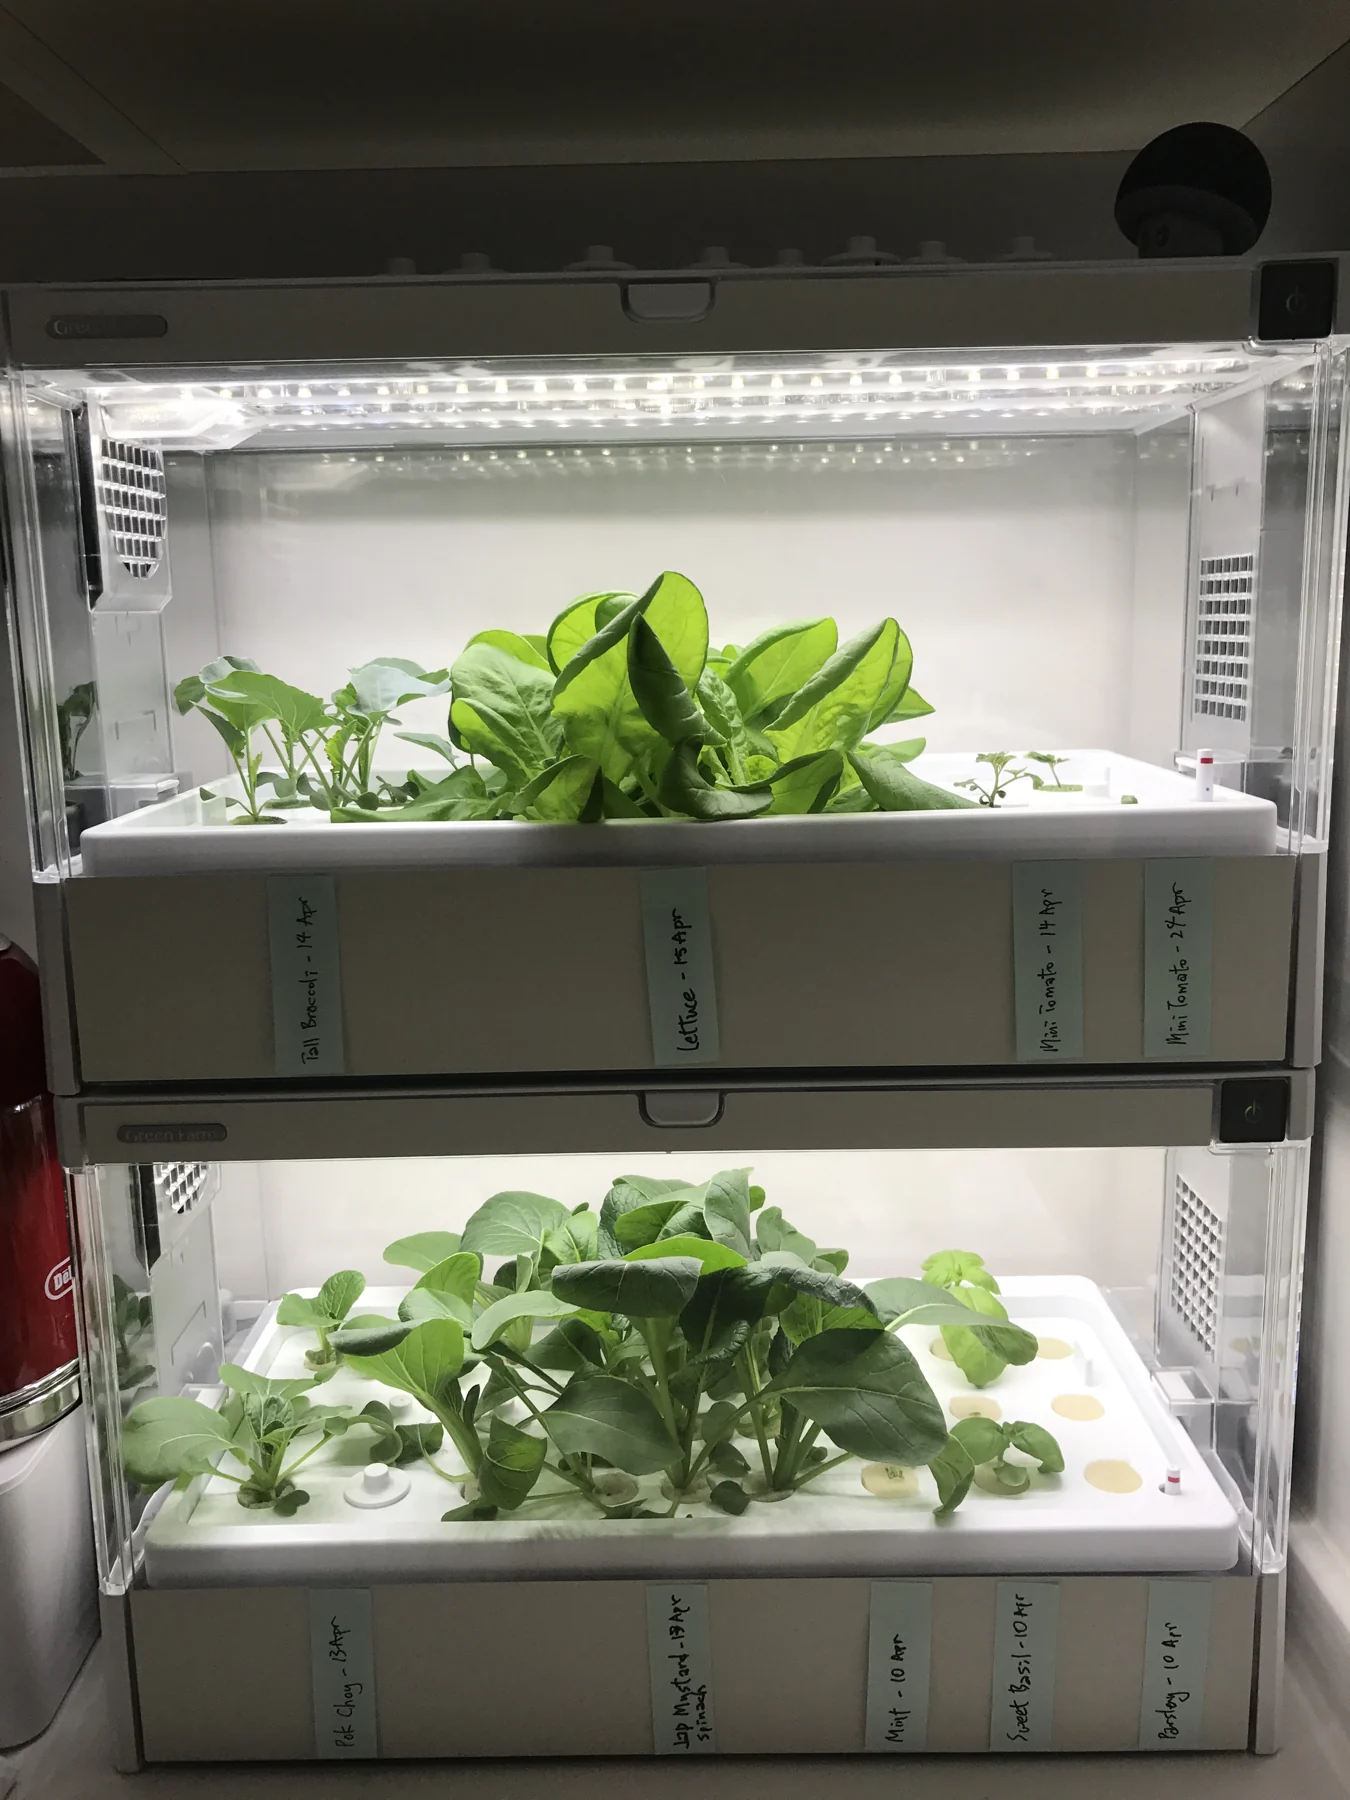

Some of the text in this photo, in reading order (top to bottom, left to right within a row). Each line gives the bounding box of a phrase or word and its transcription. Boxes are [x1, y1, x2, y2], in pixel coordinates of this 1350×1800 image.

[296, 897, 316, 926] Apr
[1039, 889, 1062, 914] Apr
[1169, 882, 1191, 915] Apr
[672, 908, 692, 944] Apr
[1039, 920, 1055, 935] 14
[1165, 916, 1186, 938] 24
[297, 932, 312, 948] 14
[674, 948, 687, 964] 15
[1037, 962, 1056, 1014] Tomato
[1167, 959, 1189, 1010] Tomato
[299, 971, 317, 1029] Broccoli
[677, 988, 699, 1050] Lettuce
[1166, 1016, 1188, 1044] Mini
[1040, 1021, 1061, 1051] Mini
[302, 1038, 319, 1064] Tall
[125, 1130, 174, 1142] Green
[669, 1595, 690, 1622] Apr
[1014, 1594, 1032, 1617] Apr
[329, 1616, 350, 1647] Apr
[1013, 1621, 1027, 1637] 10
[1162, 1623, 1181, 1647] Apr
[329, 1649, 346, 1662] 13
[891, 1634, 906, 1661] Apr
[891, 1669, 905, 1682] 10
[1008, 1655, 1031, 1693] Basil
[1163, 1656, 1178, 1669] 10
[334, 1683, 362, 1717] Choy
[885, 1708, 910, 1742] Mint
